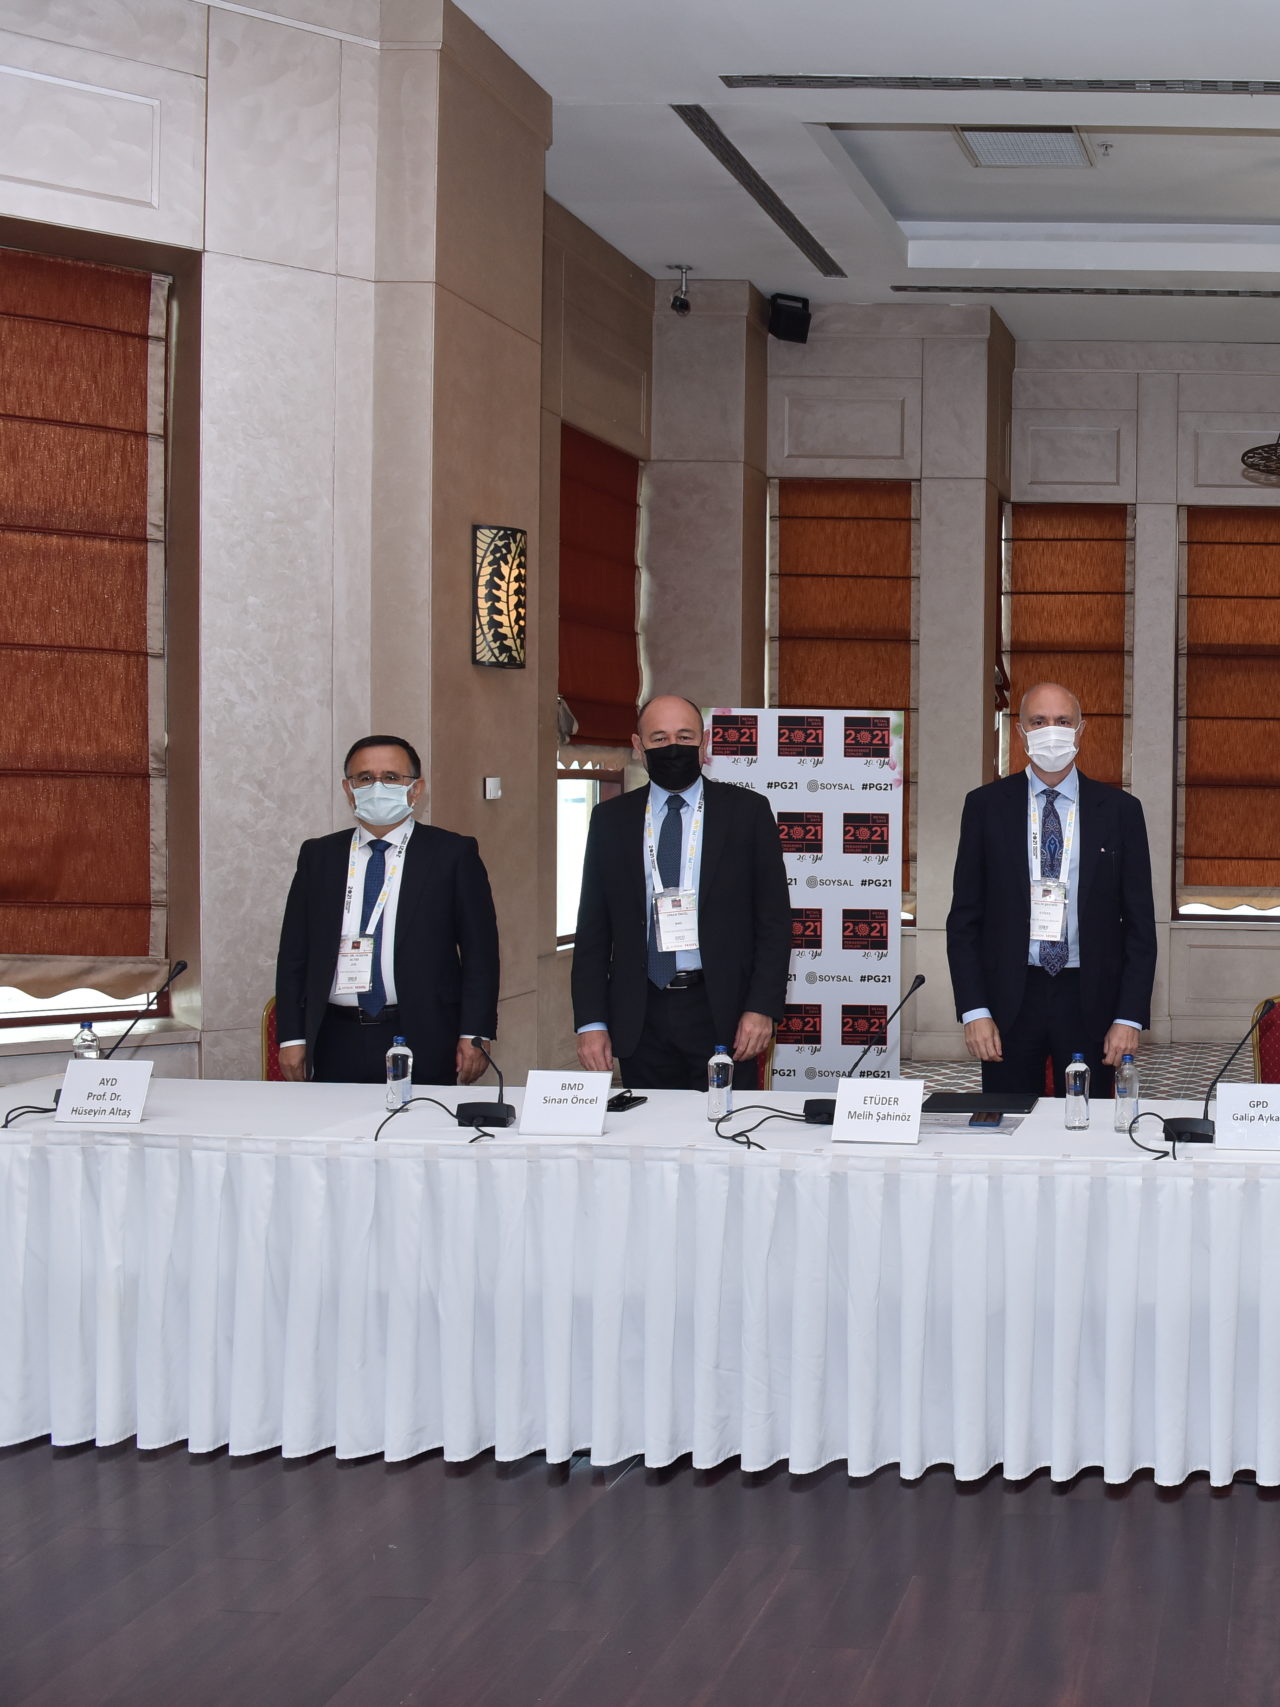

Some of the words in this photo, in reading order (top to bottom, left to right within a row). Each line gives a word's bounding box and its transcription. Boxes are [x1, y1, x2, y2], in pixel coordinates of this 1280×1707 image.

[766, 781, 798, 790] #PG21
[820, 783, 855, 791] SOYSAL
[861, 783, 893, 791] #PG21
[819, 879, 854, 887] SOYSAL
[860, 879, 892, 887] #PG21
[860, 974, 891, 983] #PG21
[772, 1069, 796, 1077] PG21
[859, 1070, 891, 1078] #PG21
[99, 1078, 117, 1086] AYD
[560, 1083, 584, 1091] BMD
[86, 1092, 107, 1101] Prof.
[110, 1093, 122, 1101] Dr.
[542, 1096, 568, 1104] Sinan
[571, 1095, 598, 1104] Öncel
[863, 1094, 899, 1106] ETÜDER
[1249, 1101, 1269, 1109] GPD
[71, 1107, 106, 1117] Hüseyin
[109, 1107, 131, 1118] Altaş
[848, 1111, 873, 1120] Melih
[876, 1111, 911, 1122] Şahinöz
[1232, 1113, 1255, 1123] Galip
